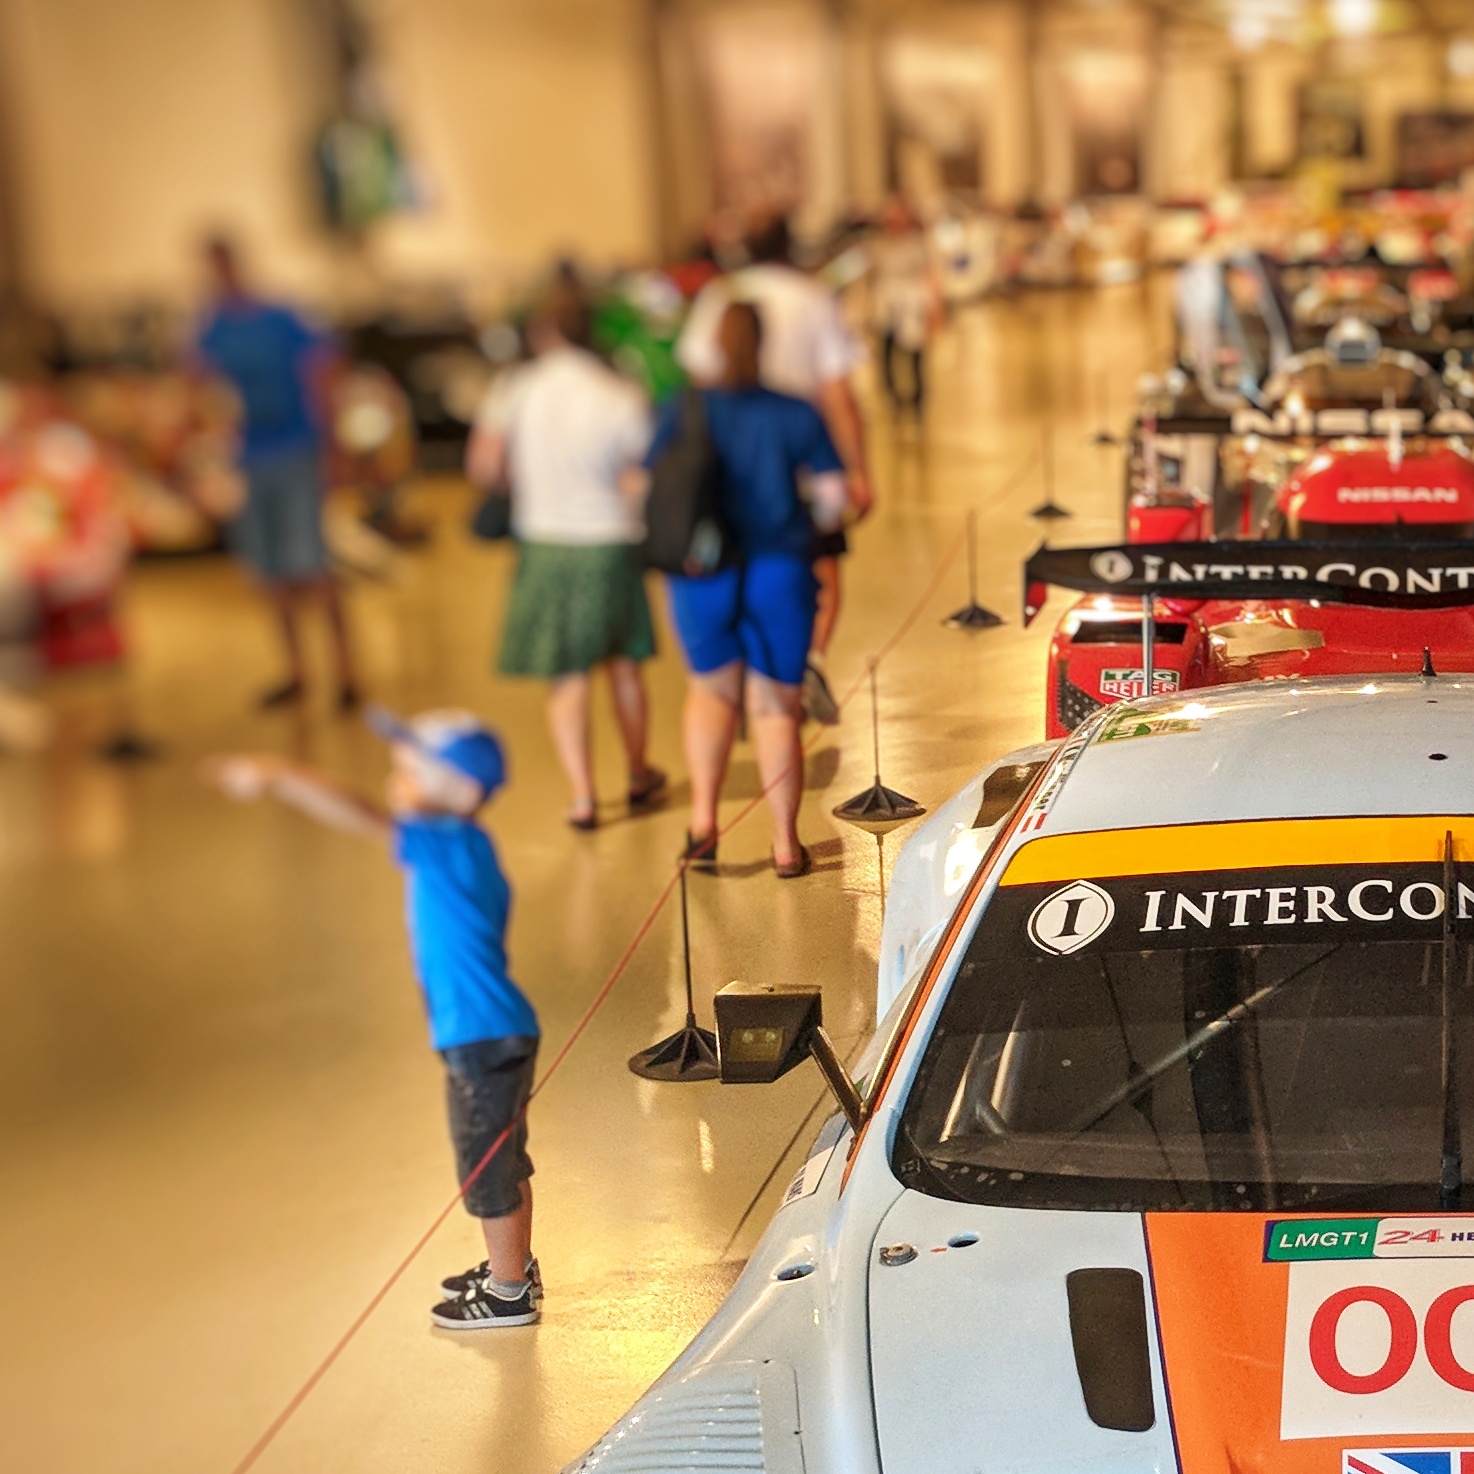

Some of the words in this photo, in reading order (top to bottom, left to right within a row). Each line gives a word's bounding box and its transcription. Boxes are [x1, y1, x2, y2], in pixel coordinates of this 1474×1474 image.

[1337, 486, 1459, 504] NISSAN
[1108, 670, 1173, 681] TAG
[1279, 1231, 1369, 1248] LMGT1
[1377, 1228, 1445, 1245] 24
